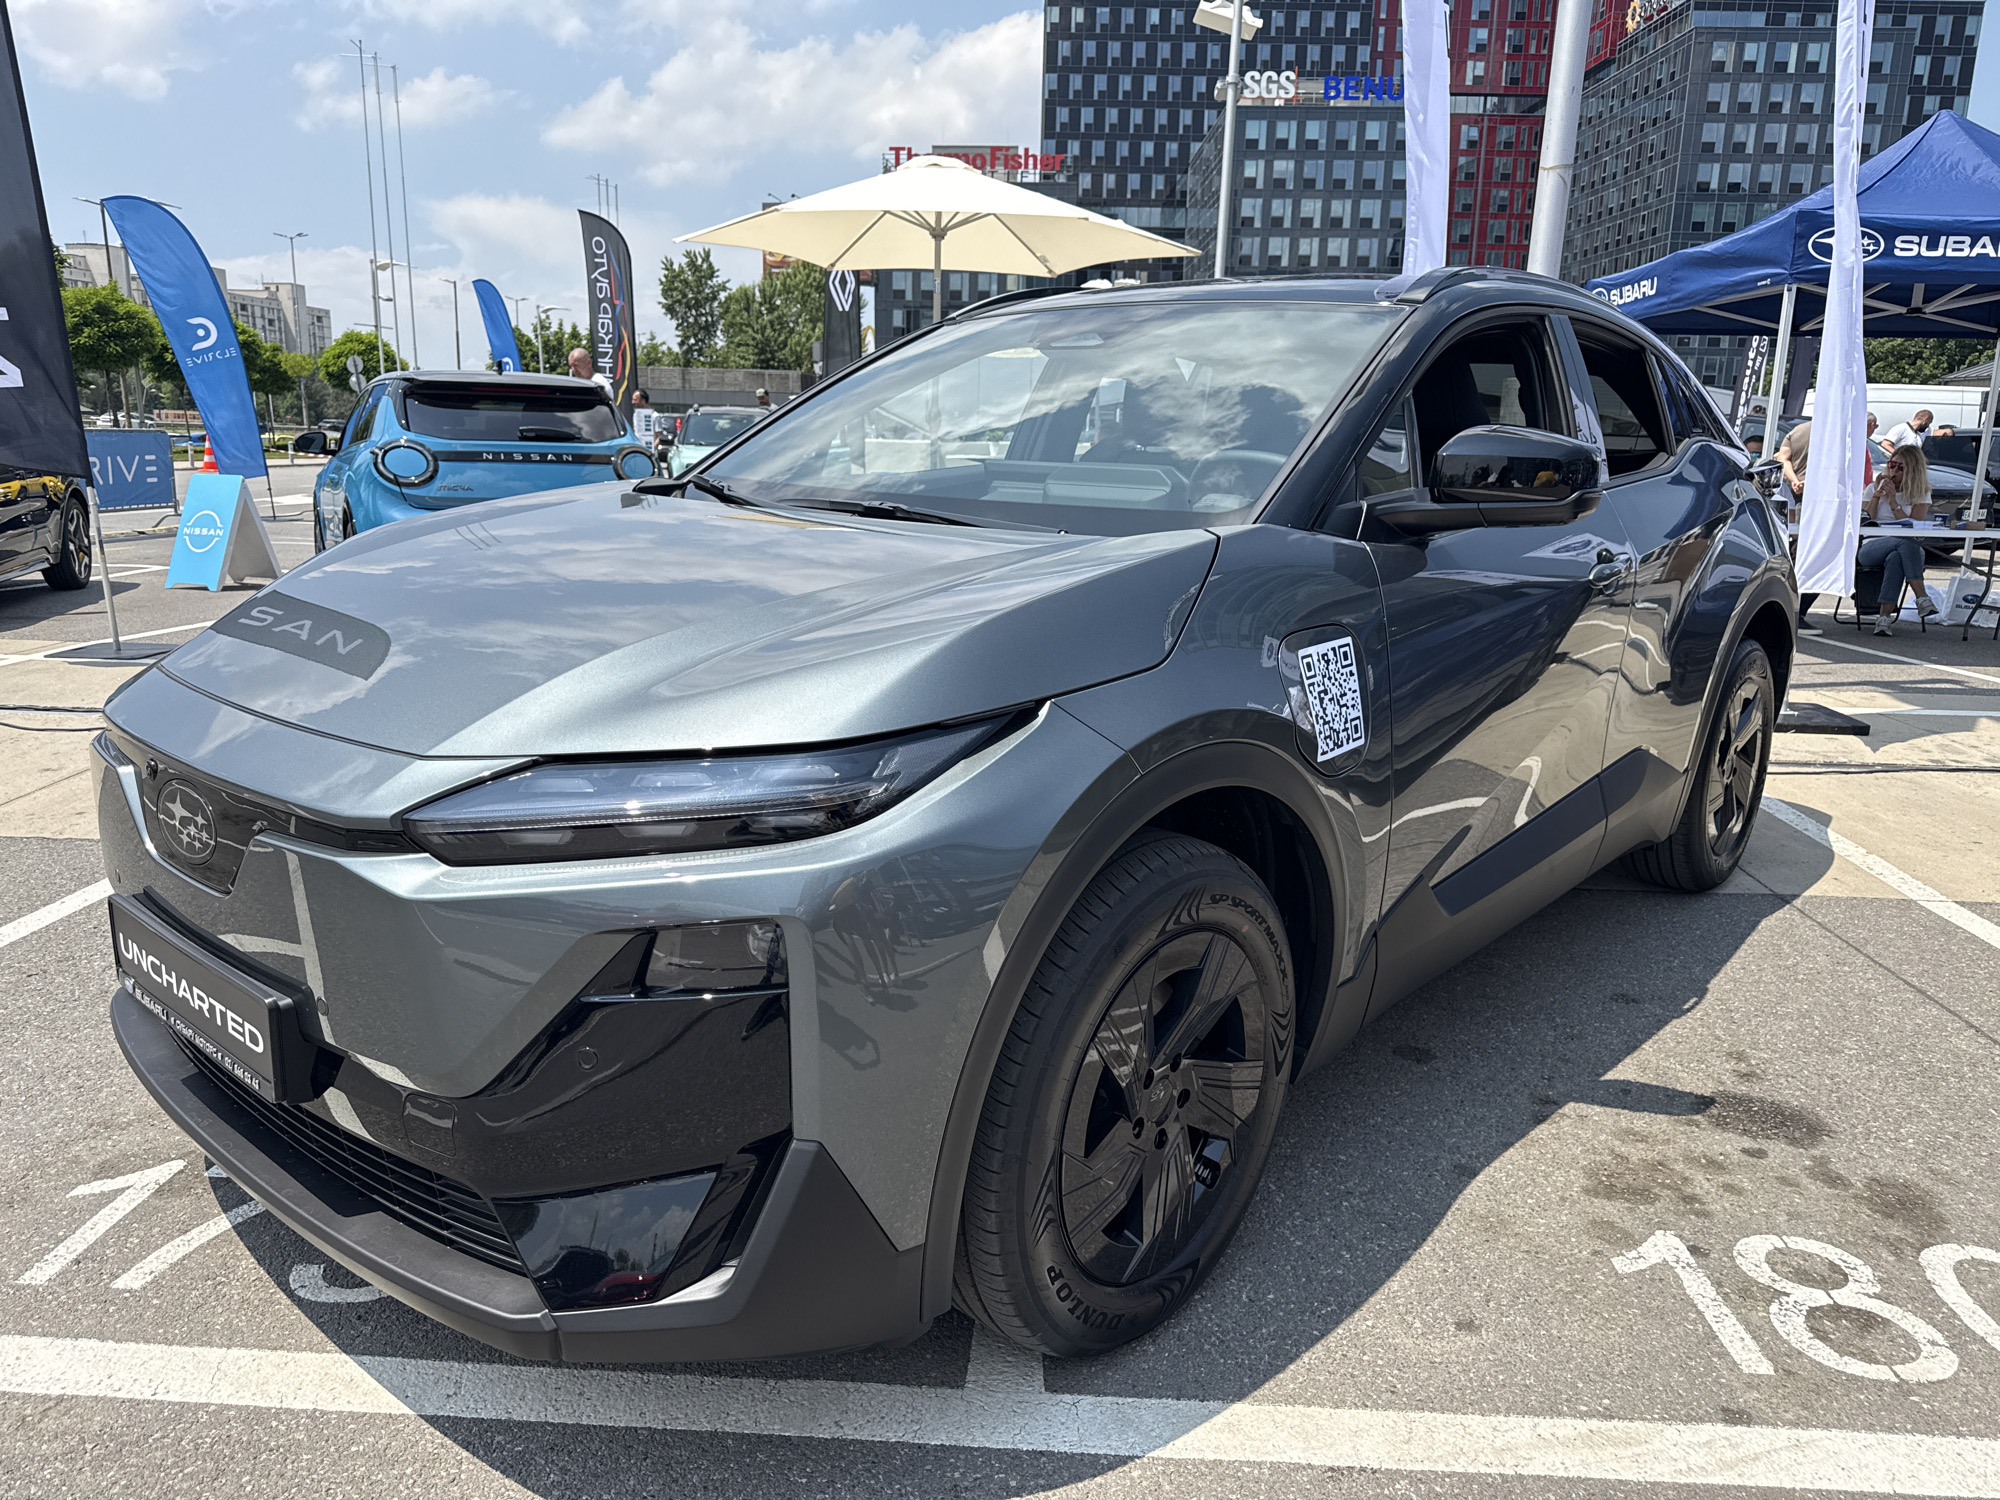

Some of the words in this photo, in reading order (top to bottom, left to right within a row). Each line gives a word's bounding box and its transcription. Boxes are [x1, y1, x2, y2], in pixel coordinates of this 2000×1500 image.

[1244, 70, 1296, 99] SGS
[1324, 75, 1404, 101] BENU
[1894, 235, 2000, 258] SUBA
[1609, 276, 1658, 306] SUBARU
[482, 452, 573, 462] NISSAN
[438, 484, 474, 492] MICRA
[183, 526, 225, 537] NISSAN
[1227, 896, 1268, 927] SPORT
[1263, 925, 1288, 986] MAXX
[119, 932, 264, 1054] UNCHARTED
[1046, 1265, 1126, 1332] DUNLOP
